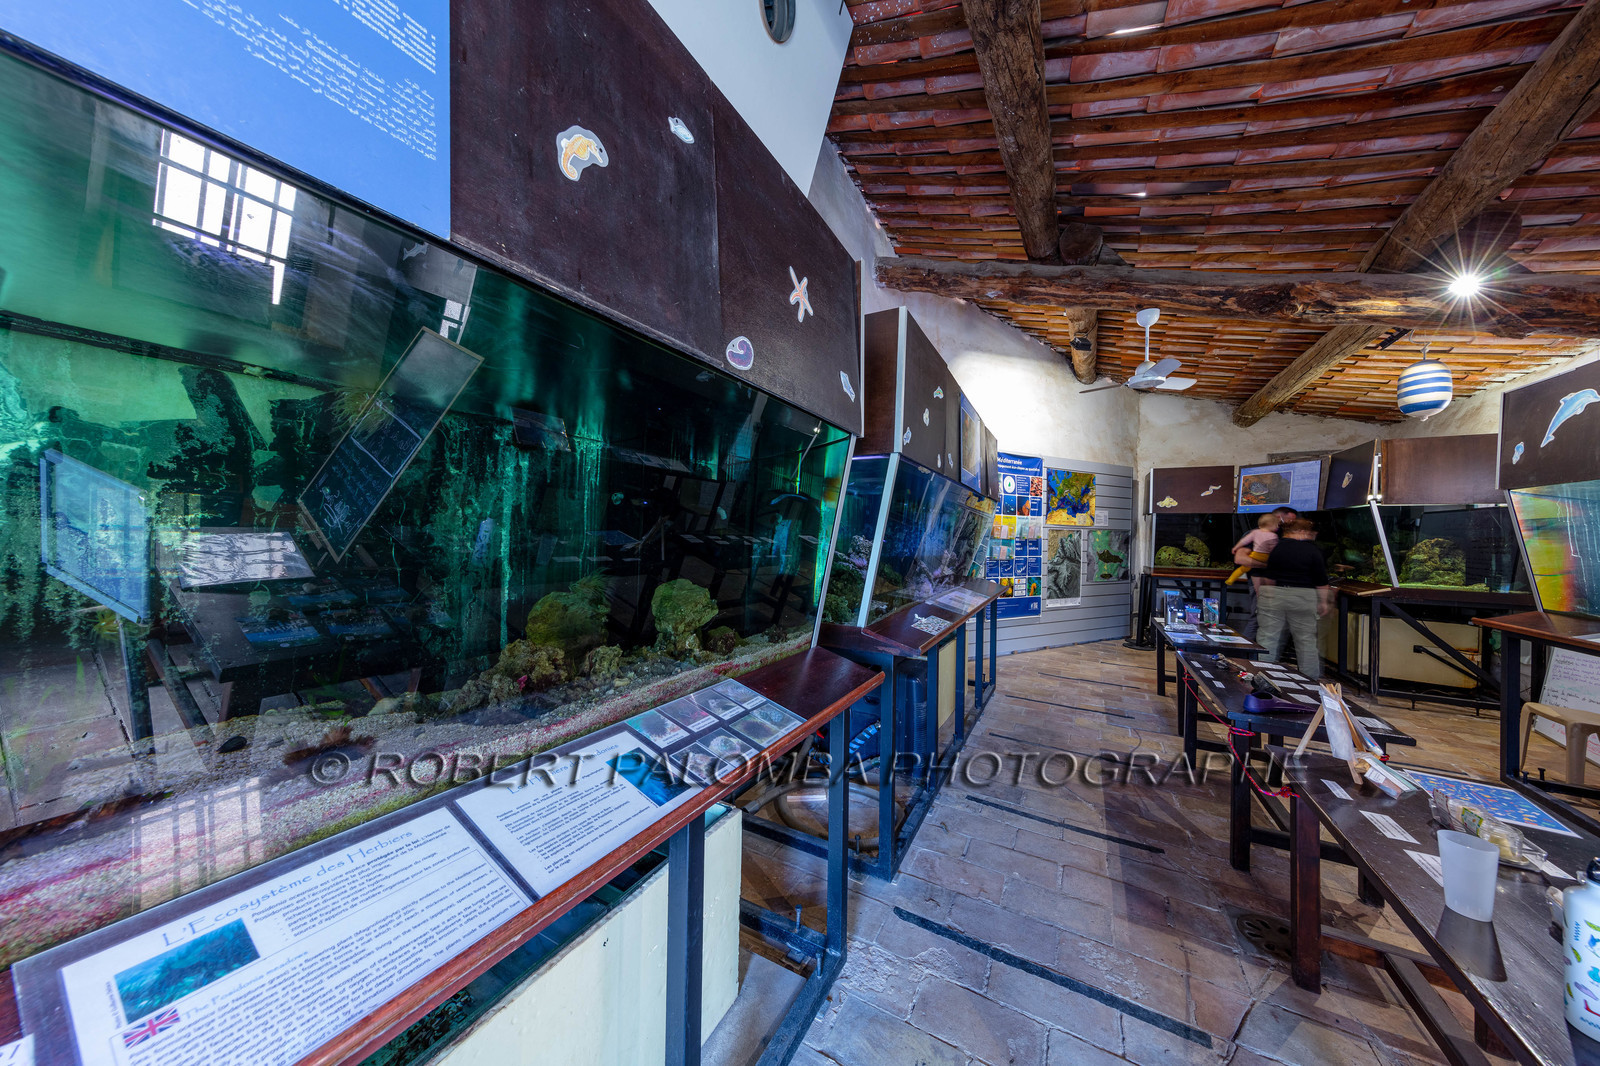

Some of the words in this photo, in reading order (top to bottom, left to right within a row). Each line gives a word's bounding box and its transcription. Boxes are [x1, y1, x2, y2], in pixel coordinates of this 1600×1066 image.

[305, 39, 358, 78] Sciaenidae
[162, 875, 312, 947] L'Ecosystème
[316, 861, 345, 877] des
[346, 832, 413, 864] Herbiers
